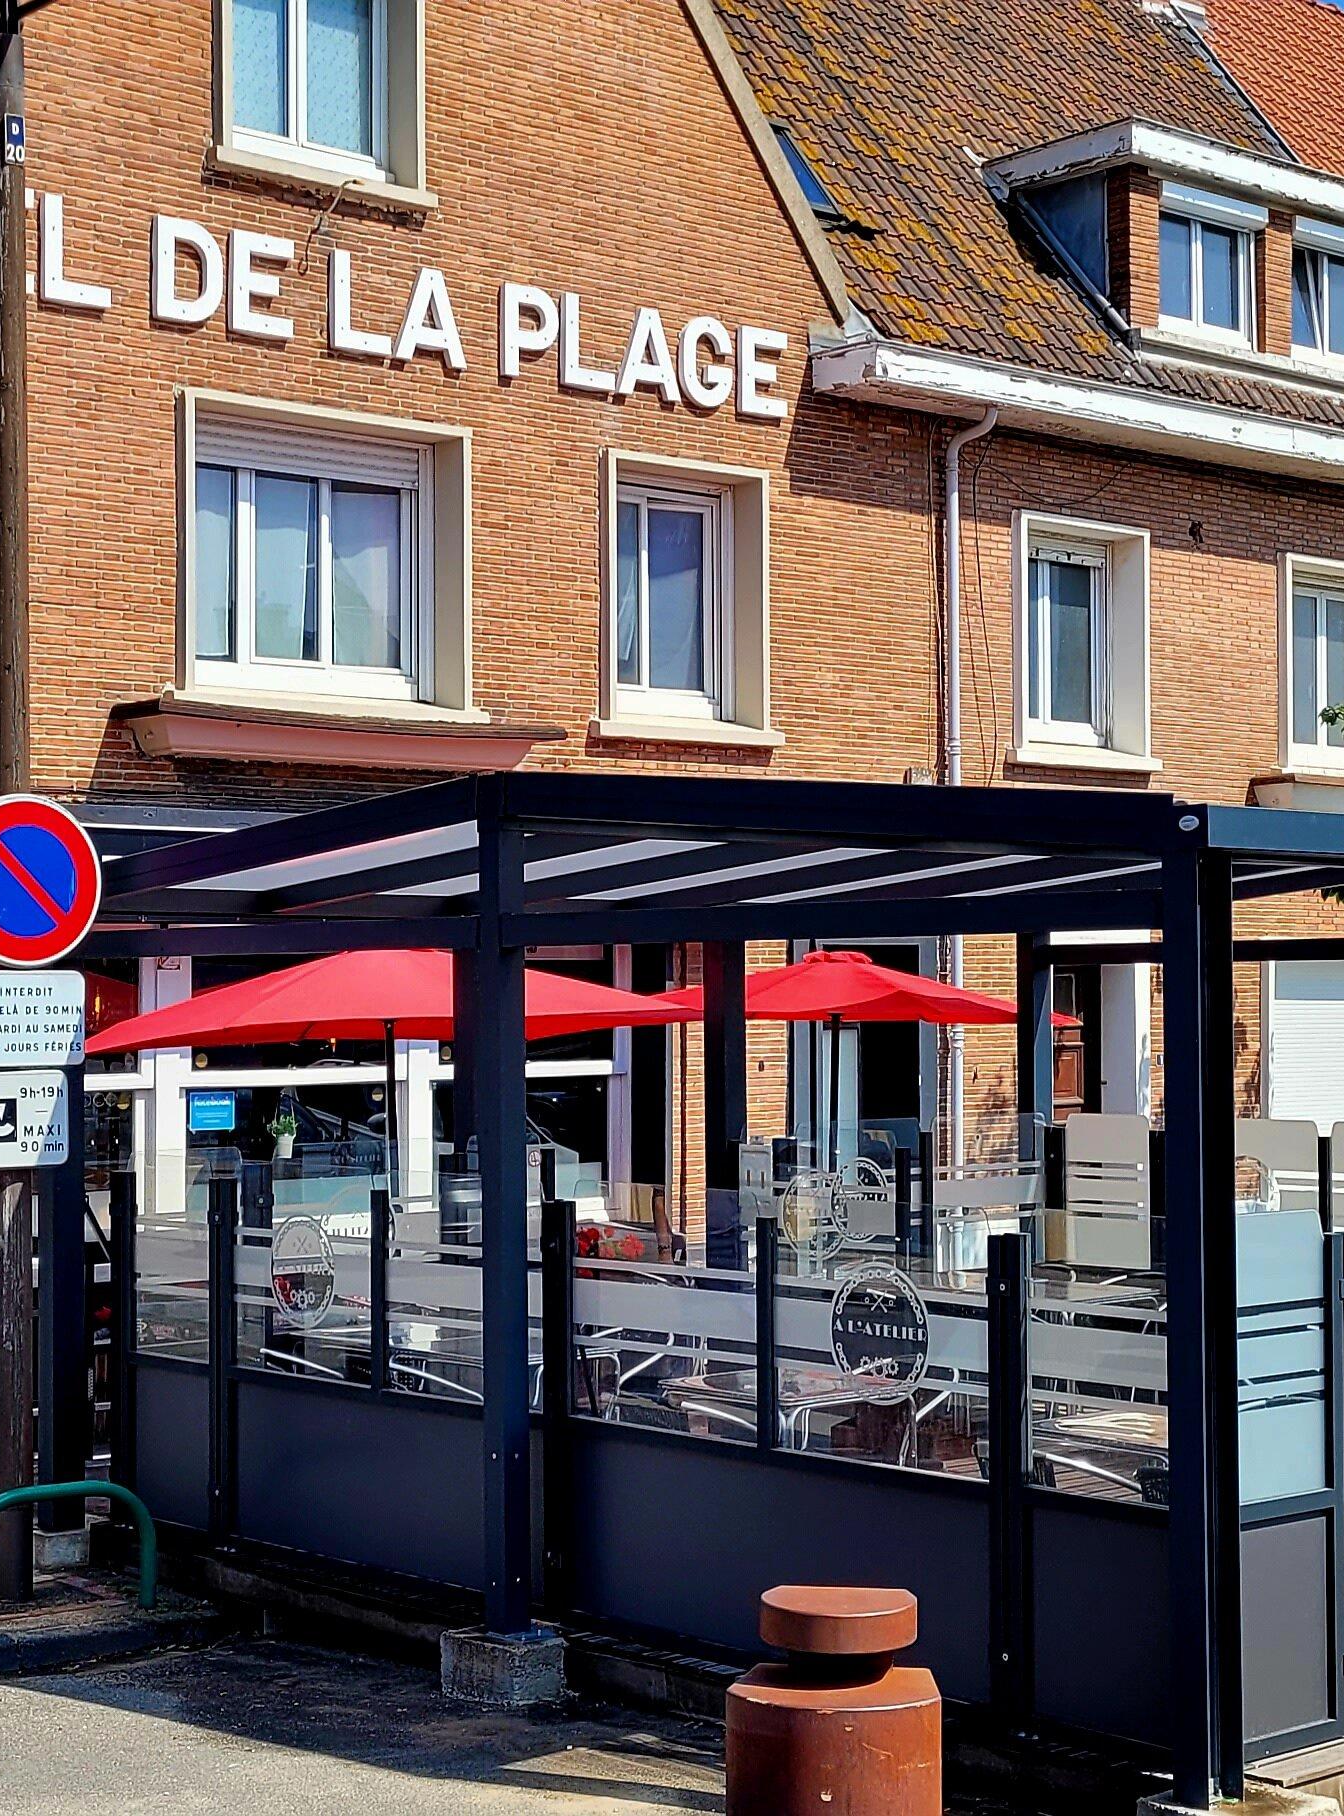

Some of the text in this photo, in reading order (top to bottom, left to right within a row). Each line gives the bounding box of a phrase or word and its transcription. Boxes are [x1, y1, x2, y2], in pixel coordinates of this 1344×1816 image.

[12, 122, 20, 136] D
[6, 143, 25, 162] 20
[152, 214, 295, 338] DE
[328, 250, 468, 370] LA
[500, 281, 789, 418] PLAGE
[0, 987, 54, 997] INTERDIT
[26, 1006, 38, 1016] DE
[26, 1024, 38, 1034] AU
[43, 1024, 82, 1033] SAMEDI
[4, 1042, 39, 1052] JOURS
[24, 1124, 61, 1137] MAXI
[20, 1140, 64, 1152] 90 min
[834, 1318, 928, 1342] A L'ATELIER
